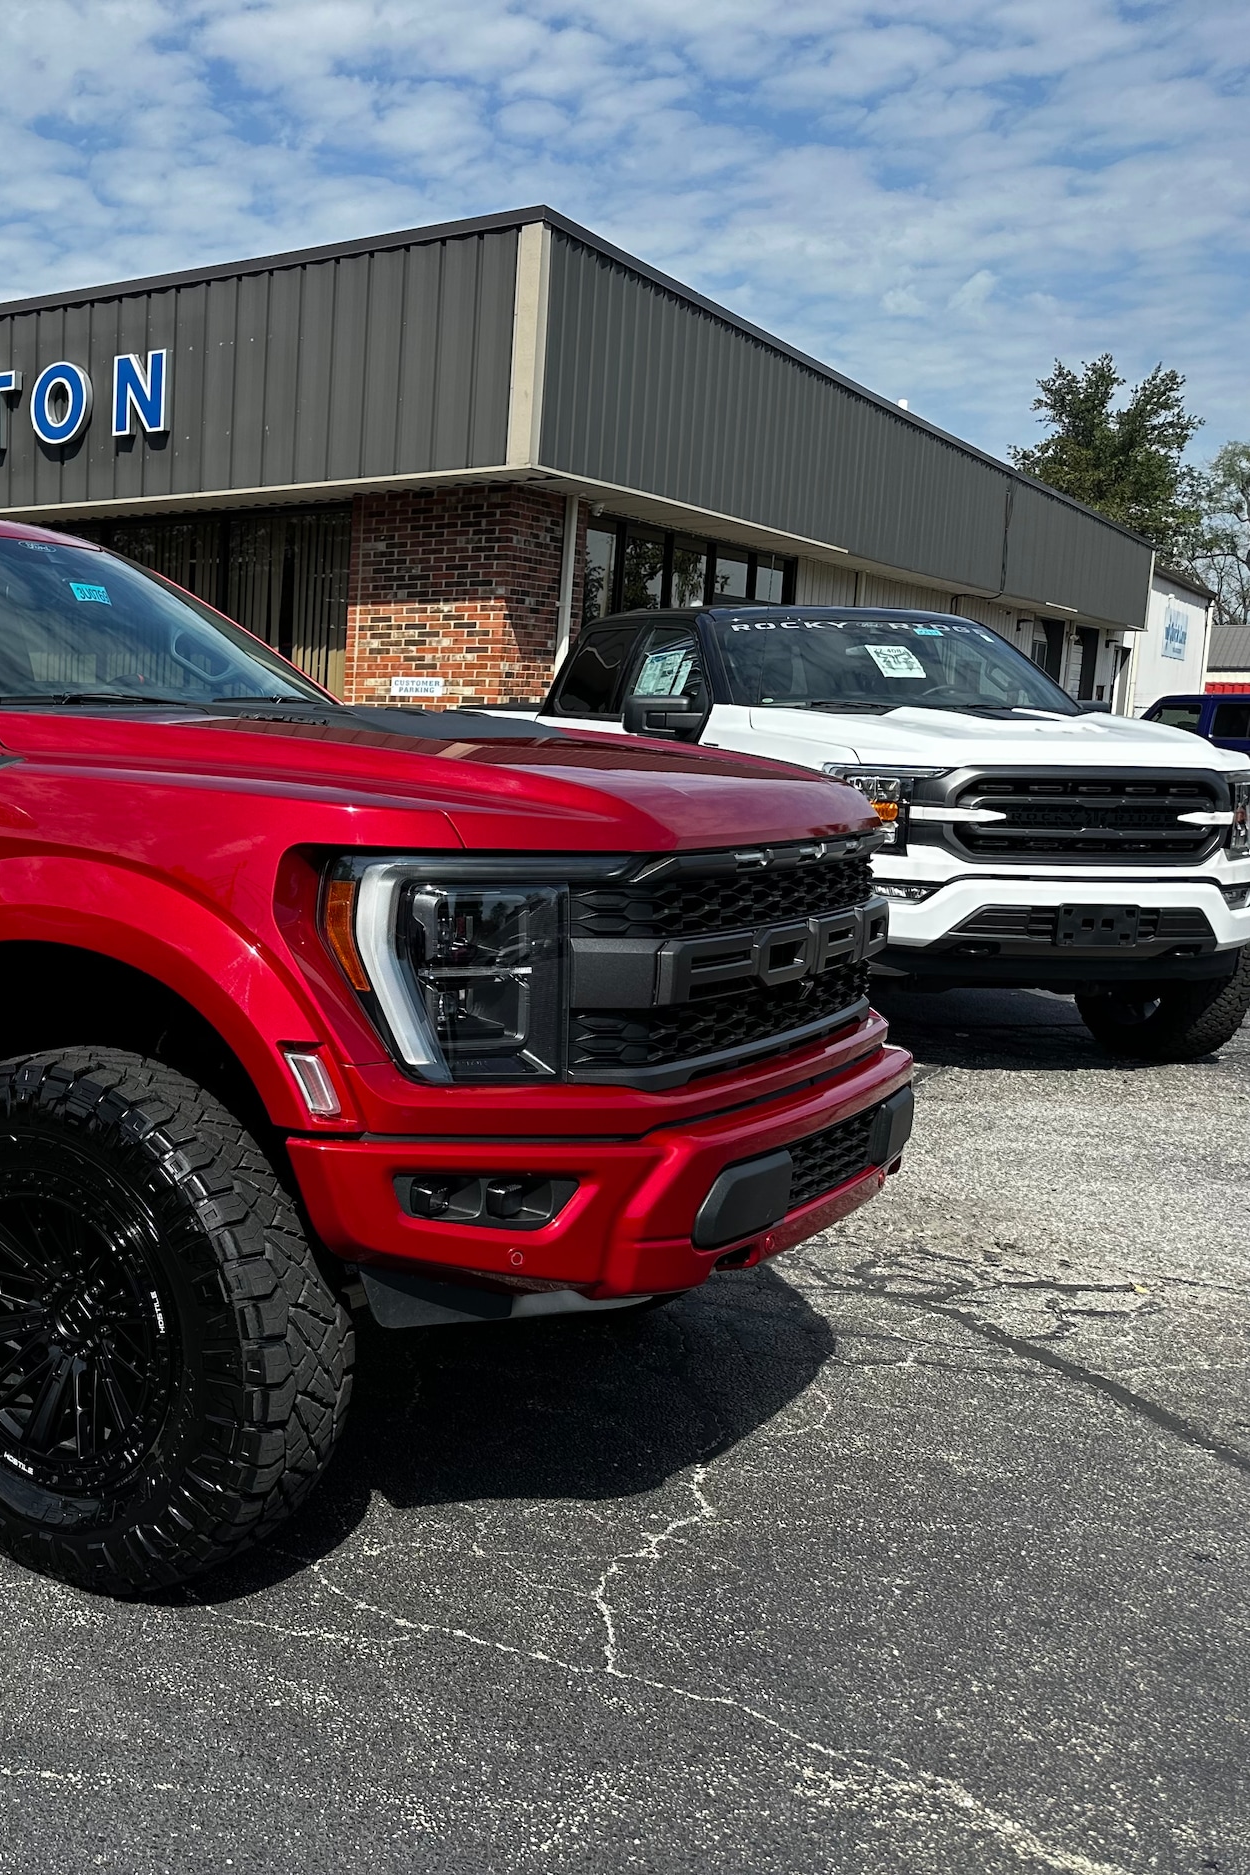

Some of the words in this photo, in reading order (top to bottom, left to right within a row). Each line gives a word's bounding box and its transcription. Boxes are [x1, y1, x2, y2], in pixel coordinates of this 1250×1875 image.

[731, 621, 848, 632] ROCKY
[1010, 812, 1078, 821] ROCKY
[1114, 813, 1177, 822] RIDGE
[656, 899, 889, 1005] FORD
